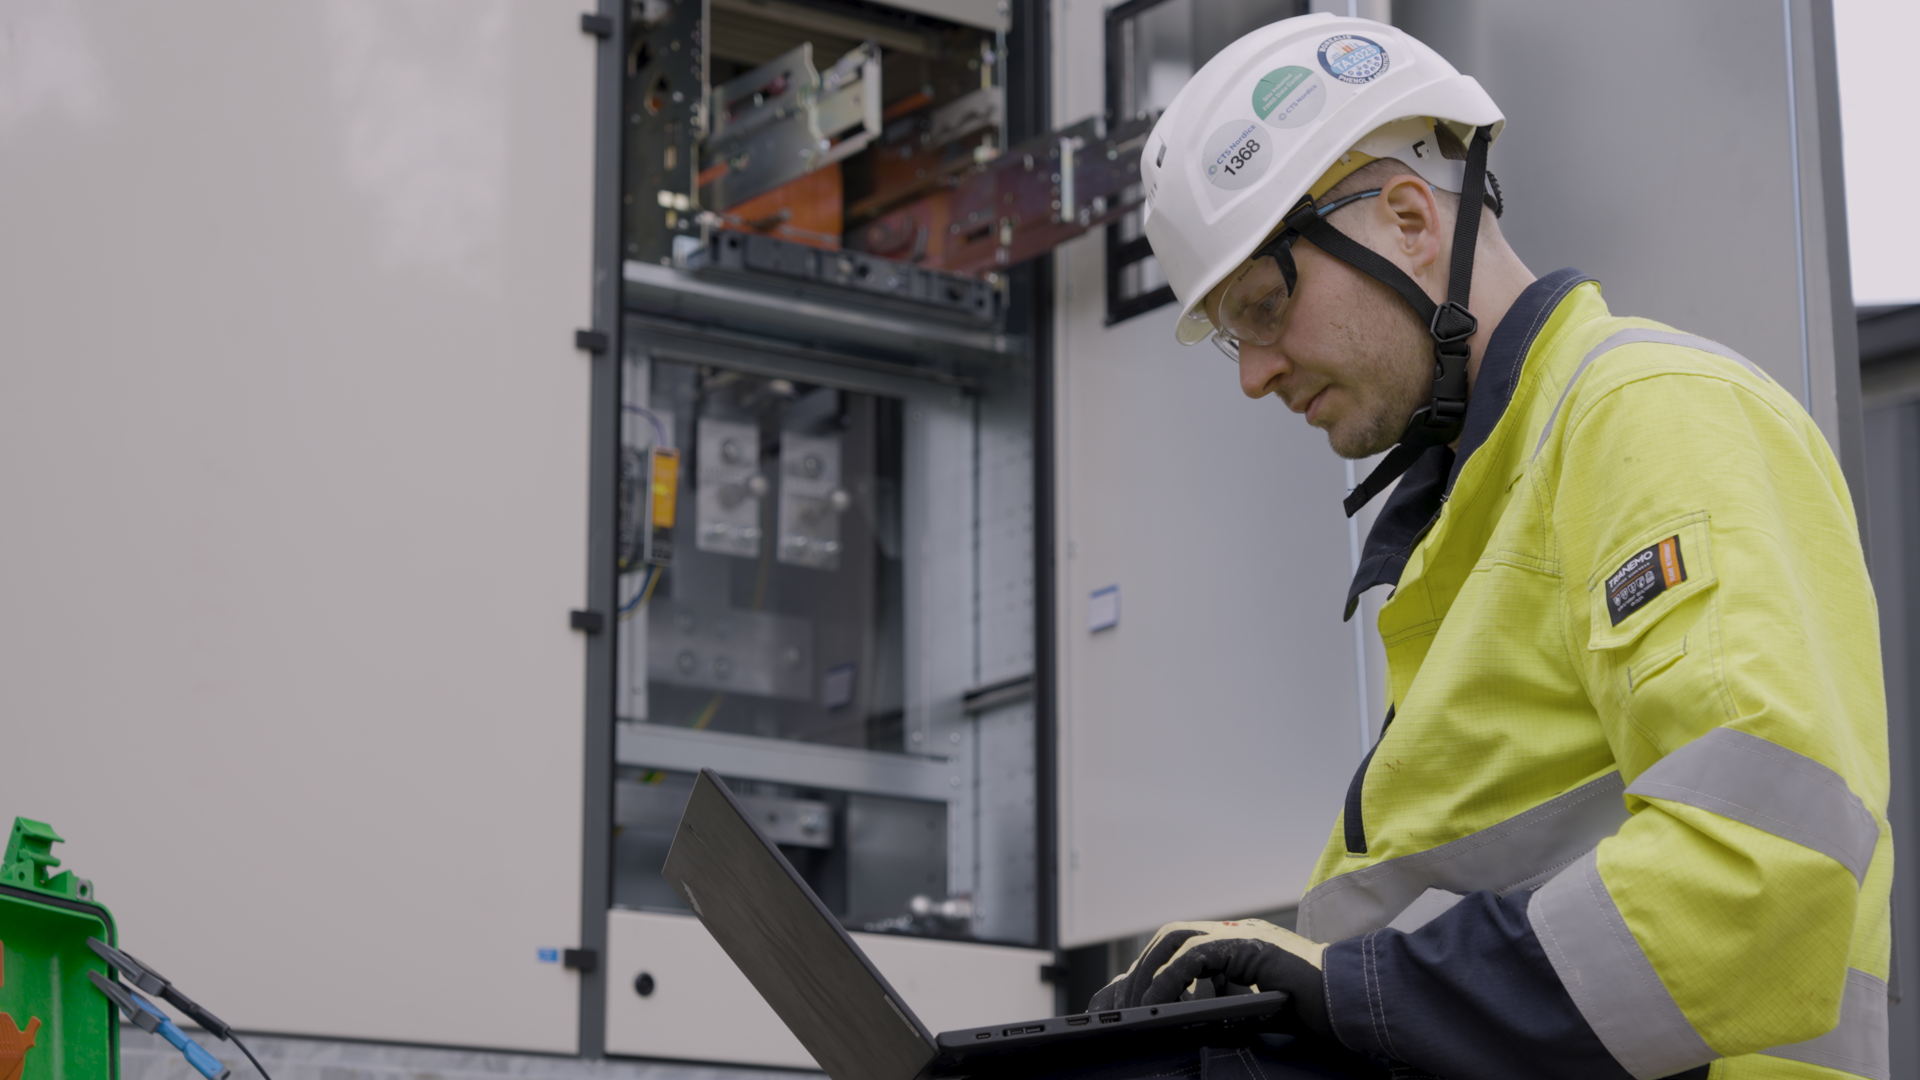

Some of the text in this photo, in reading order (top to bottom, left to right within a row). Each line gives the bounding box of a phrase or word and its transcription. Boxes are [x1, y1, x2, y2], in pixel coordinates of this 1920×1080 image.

[1333, 45, 1377, 71] TA 2025
[1338, 74, 1368, 84] PHENOL
[1285, 84, 1317, 114] CTS Nordics
[1216, 124, 1256, 165] CTS Nordics
[1224, 139, 1261, 176] 1368
[1608, 550, 1653, 588] TRANEMO
